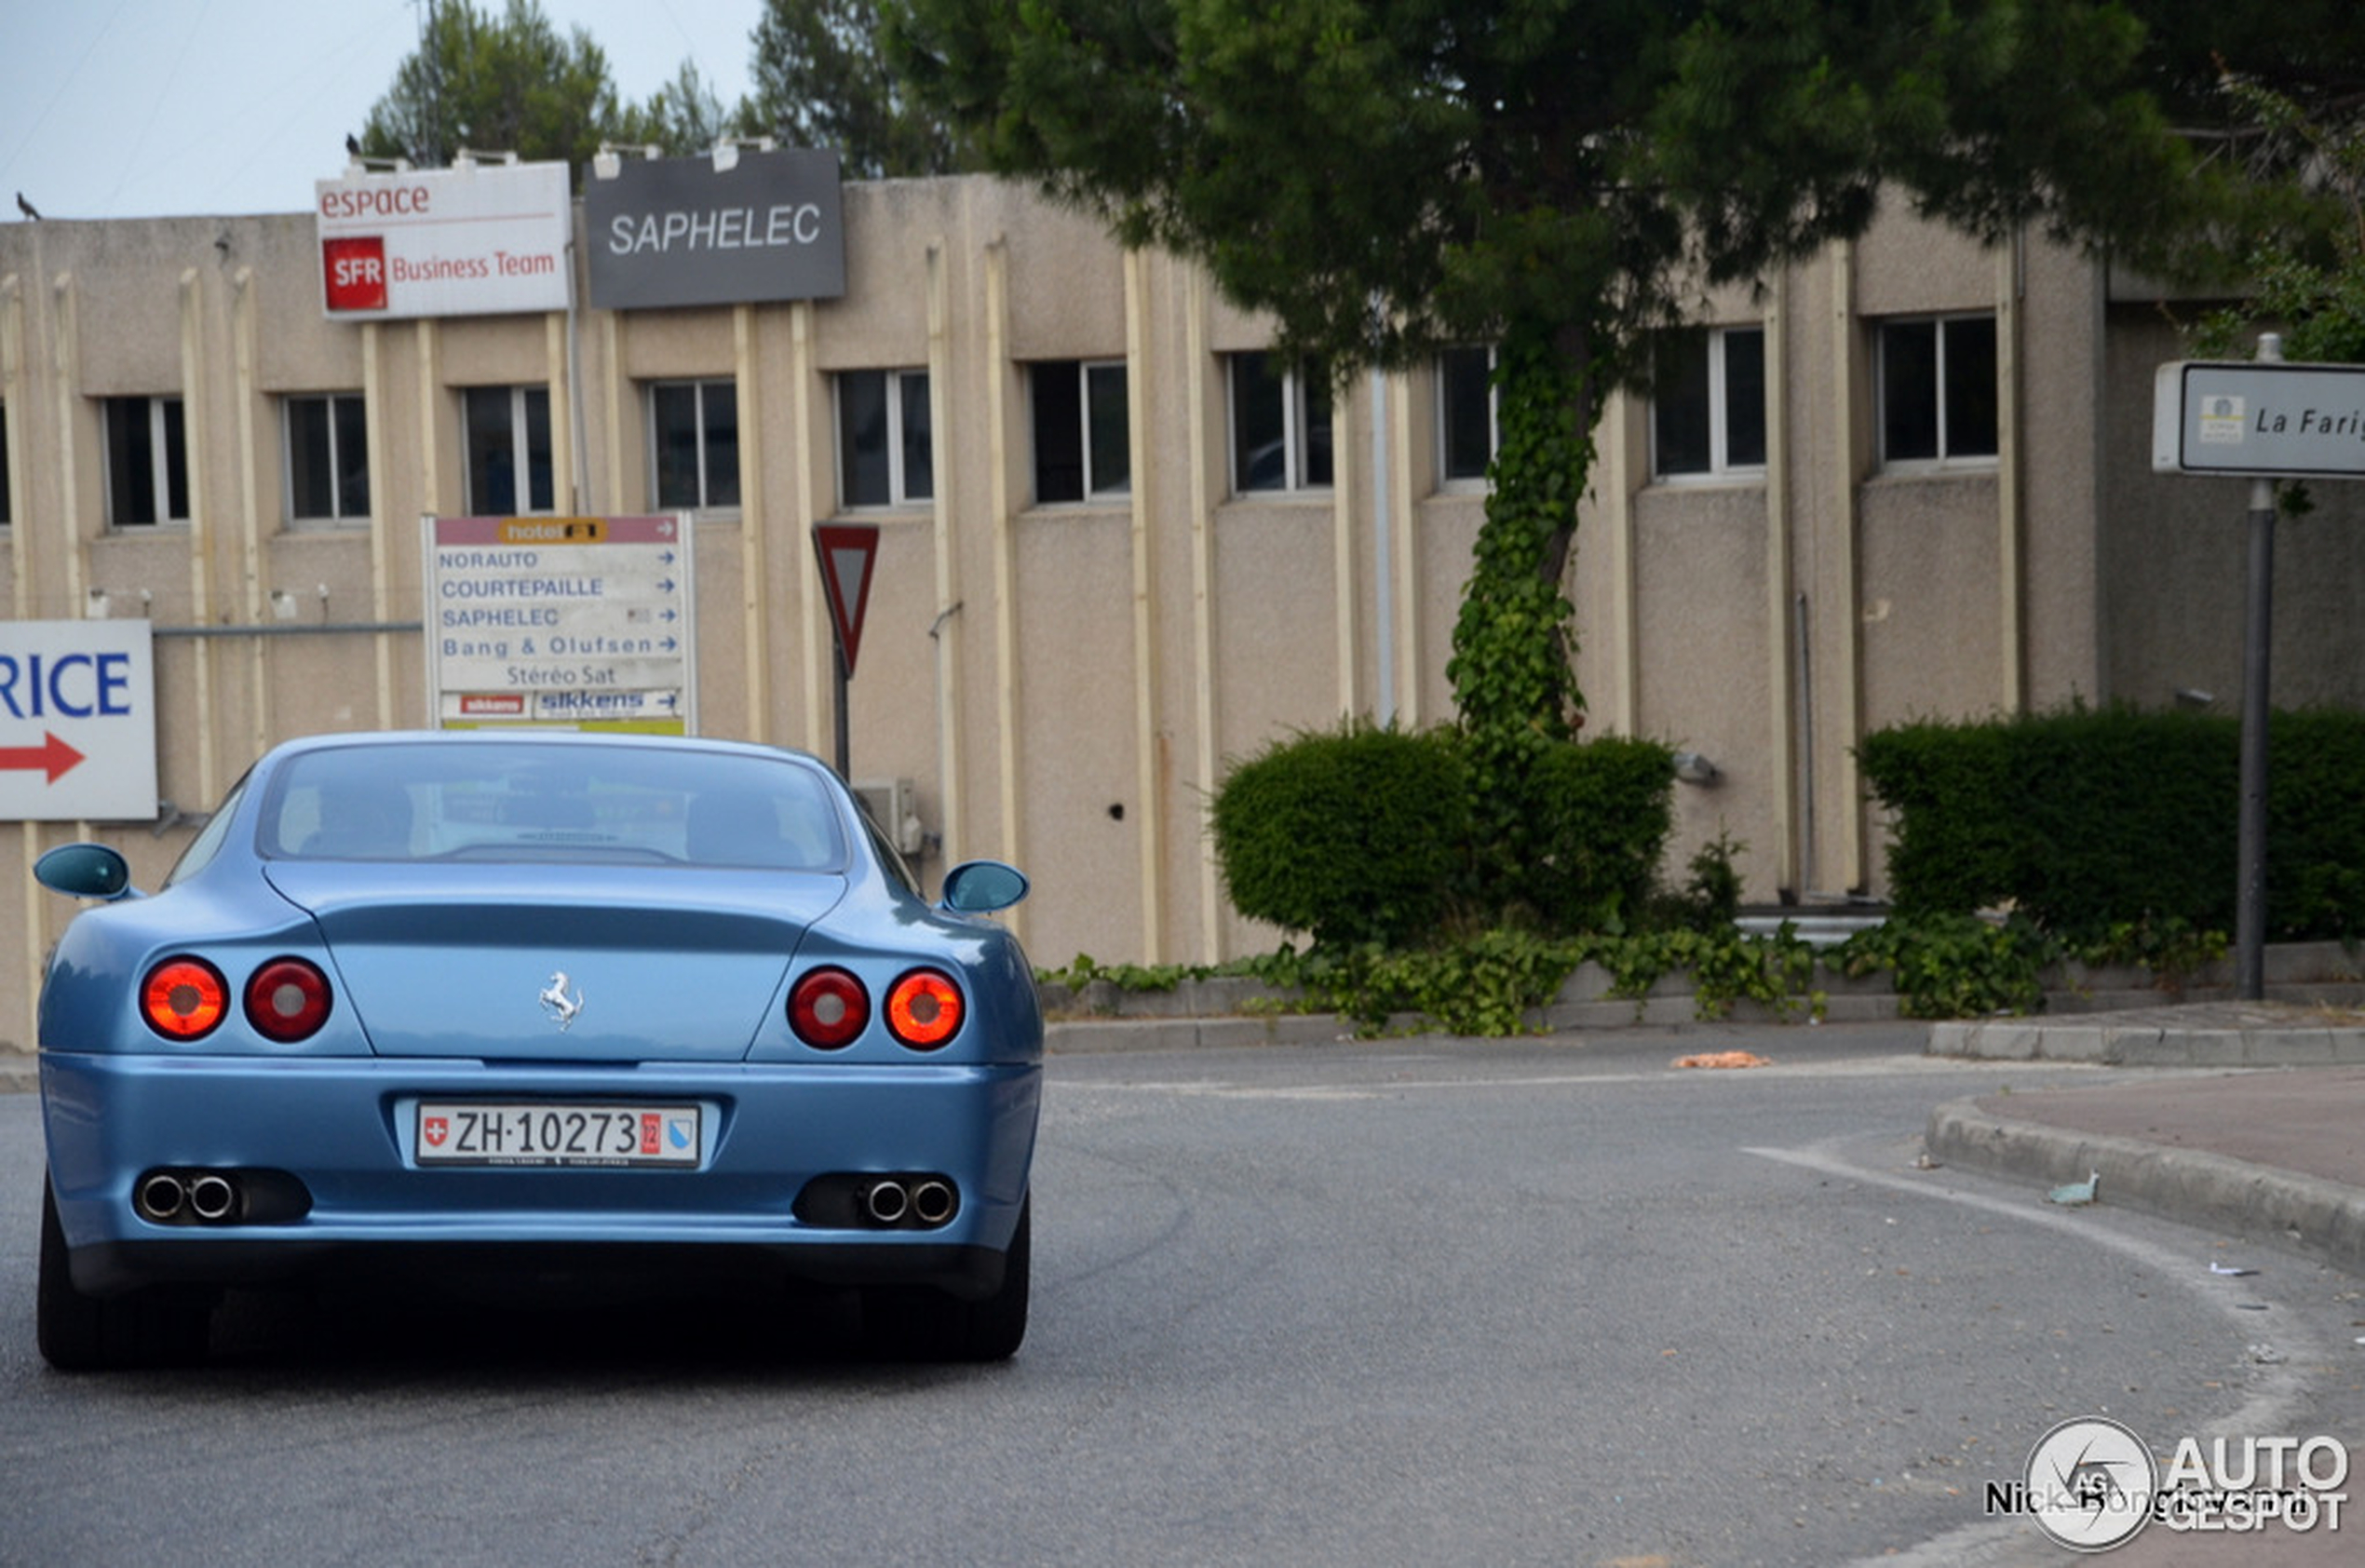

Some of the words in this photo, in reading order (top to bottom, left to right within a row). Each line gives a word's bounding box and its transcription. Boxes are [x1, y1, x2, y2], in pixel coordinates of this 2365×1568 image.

[321, 186, 429, 218] espace
[609, 204, 821, 254] SAPHELEC
[334, 258, 383, 286] SFR
[393, 255, 488, 281] Business
[493, 251, 555, 277] Team
[2256, 408, 2288, 433] La
[2300, 409, 2365, 442] Fari
[439, 551, 538, 568] NORAUTO
[441, 578, 603, 598] COURTEPAILLE
[442, 608, 559, 627] SAPHELEC
[443, 639, 507, 657] Bang
[521, 639, 535, 654] &
[549, 637, 651, 654] Olufsen
[0, 653, 131, 720] RICE
[507, 665, 576, 684] Stéréo
[582, 665, 615, 684] Sat
[541, 690, 643, 710] sikkens
